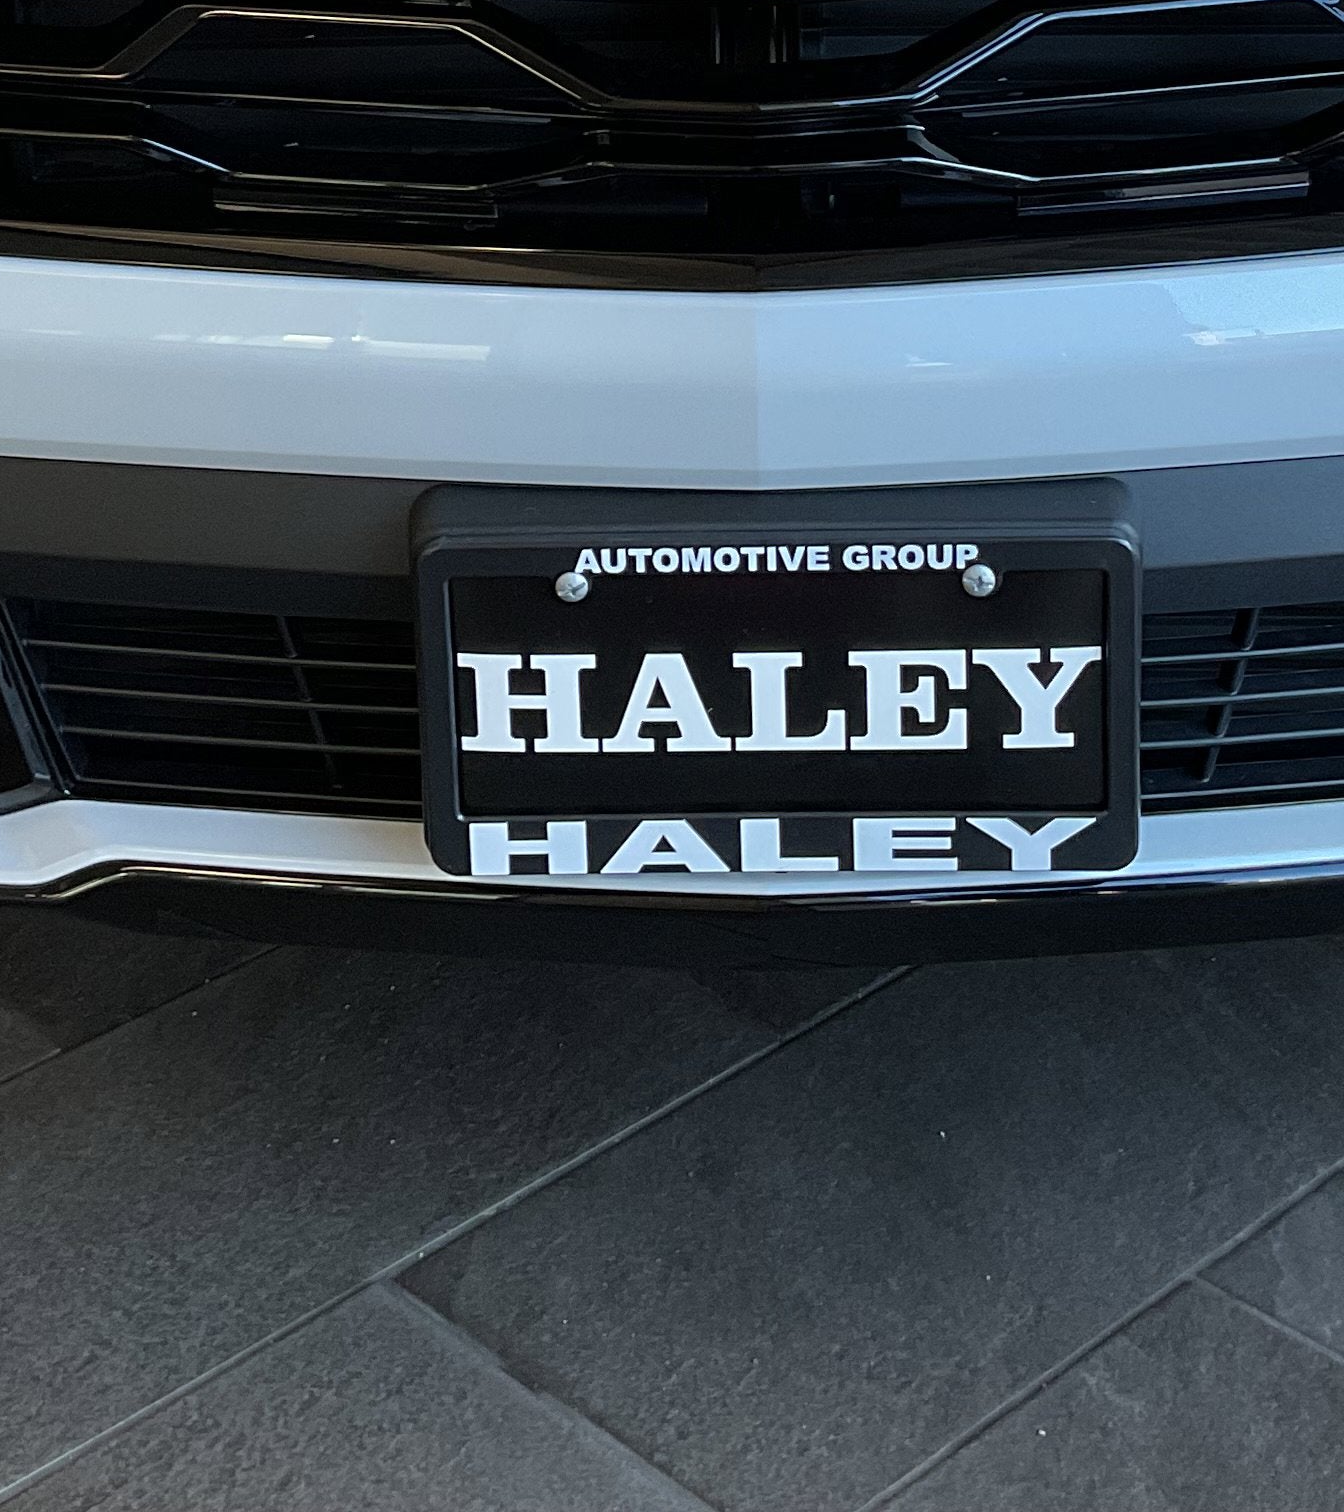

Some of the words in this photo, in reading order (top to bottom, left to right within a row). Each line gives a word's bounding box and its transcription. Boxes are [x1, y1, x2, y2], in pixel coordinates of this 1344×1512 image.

[574, 545, 831, 575] AUTOMOTIVE
[841, 543, 980, 572] GROUP
[456, 644, 1103, 754] HALEY
[467, 815, 1098, 877] HALEY
